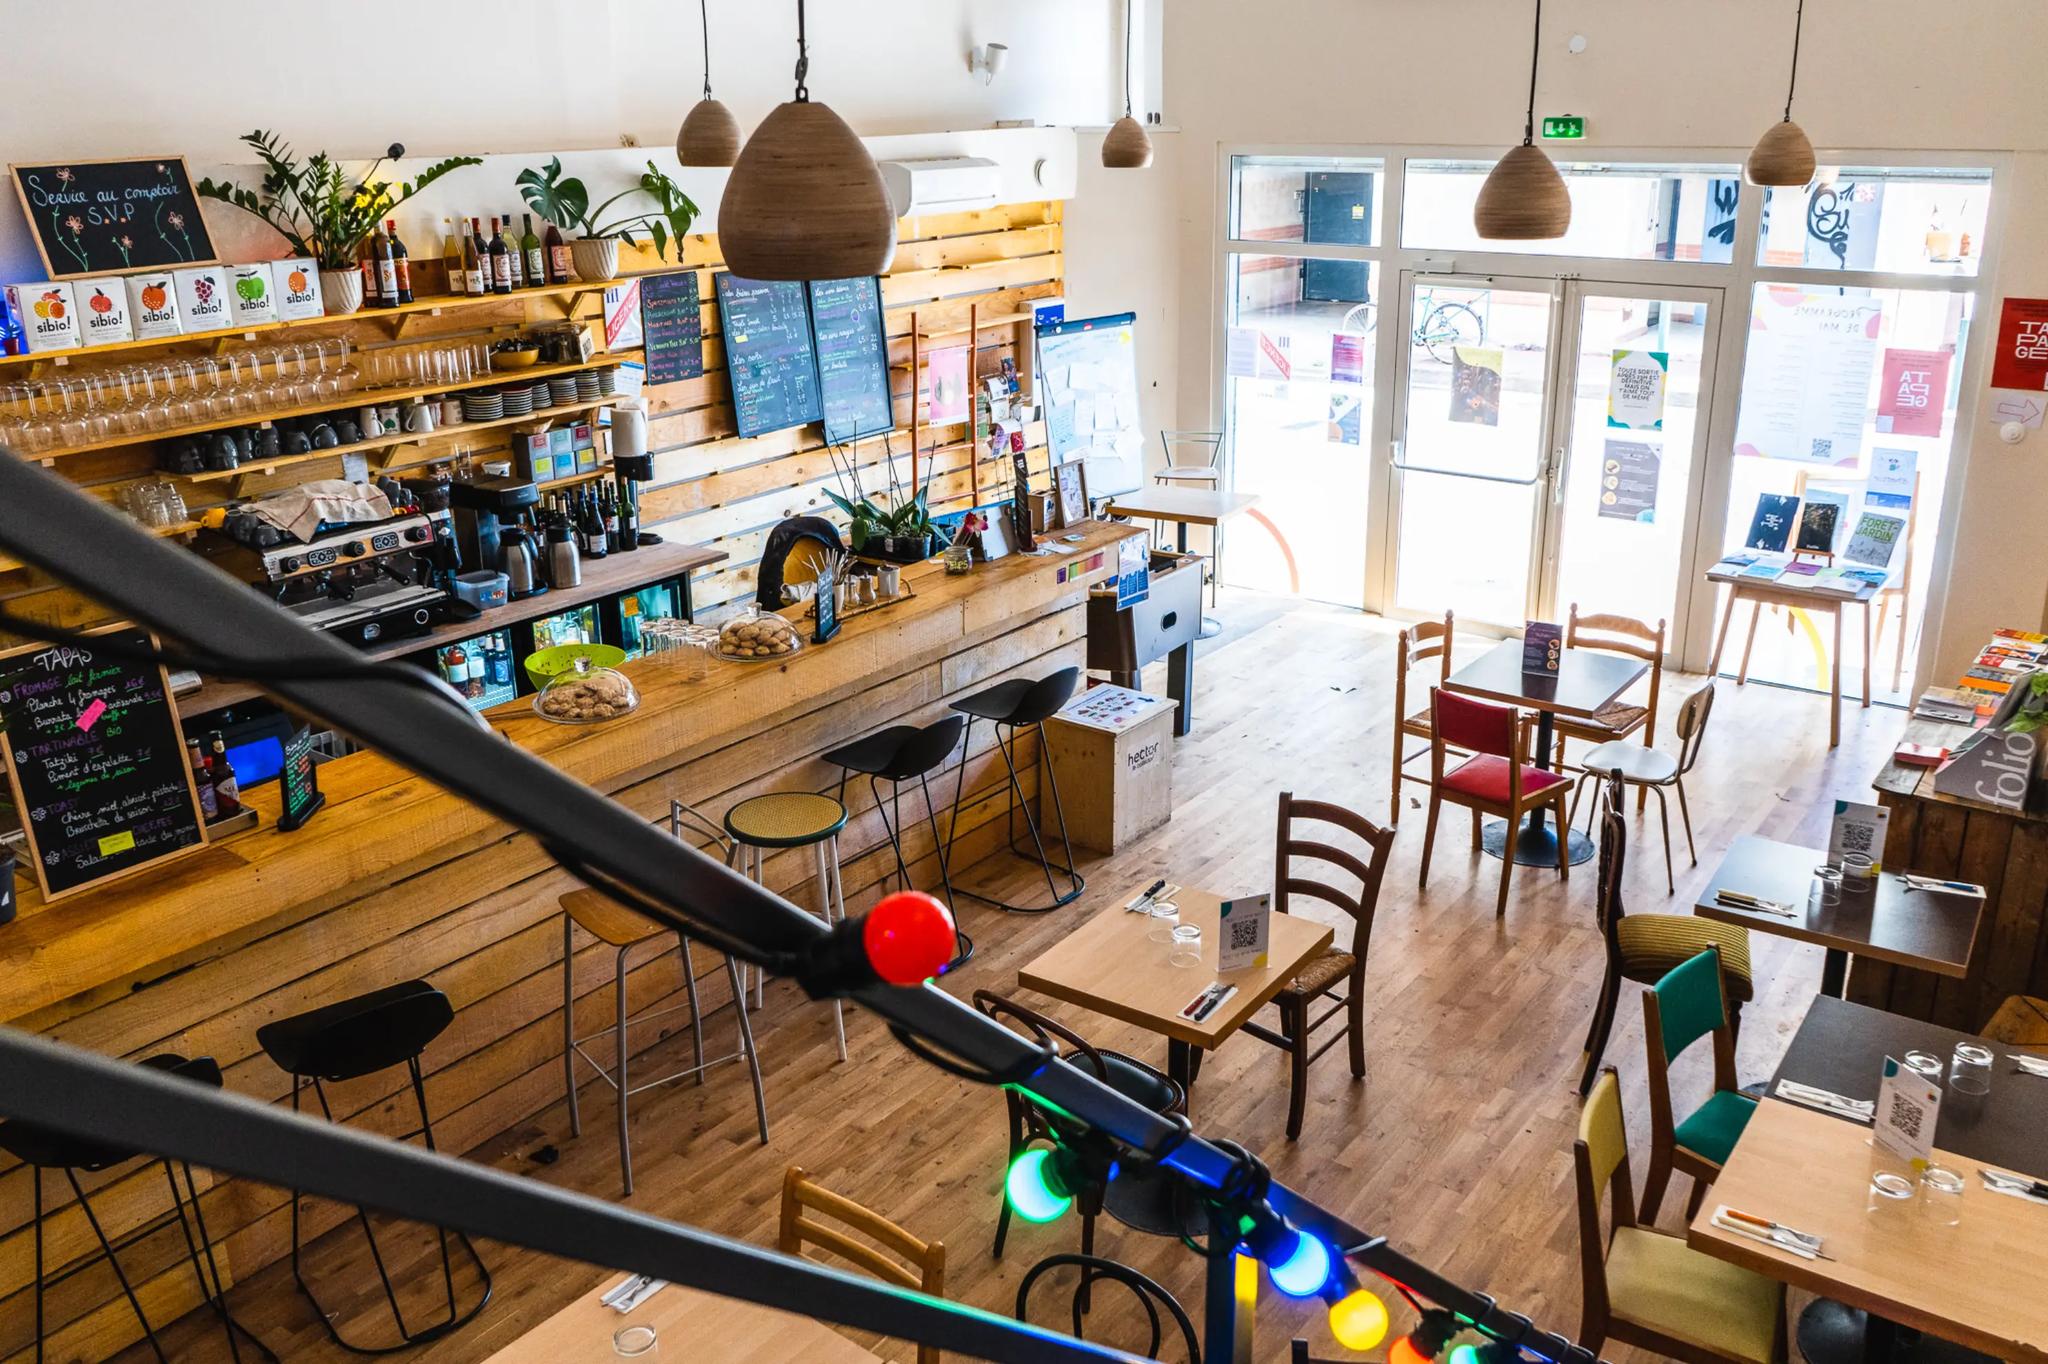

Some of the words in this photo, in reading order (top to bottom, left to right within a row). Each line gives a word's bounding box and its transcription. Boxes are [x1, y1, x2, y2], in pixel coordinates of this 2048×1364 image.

[28, 175, 88, 206] Service
[96, 191, 119, 202] au
[124, 183, 180, 201] comptoir
[240, 295, 270, 310] sibio!
[287, 288, 315, 304] sibio!
[142, 306, 174, 323] sibio!
[192, 299, 222, 315] sibio!
[37, 316, 71, 333] sibio!
[90, 311, 123, 328] sibio!
[2015, 346, 2048, 360] GE
[1855, 527, 1894, 542] JARDIN
[33, 648, 93, 671] TAPAS
[13, 676, 63, 699] FROMAGE
[27, 696, 63, 713] Planche
[1127, 742, 1159, 767] hector
[1975, 732, 2036, 810] folio
